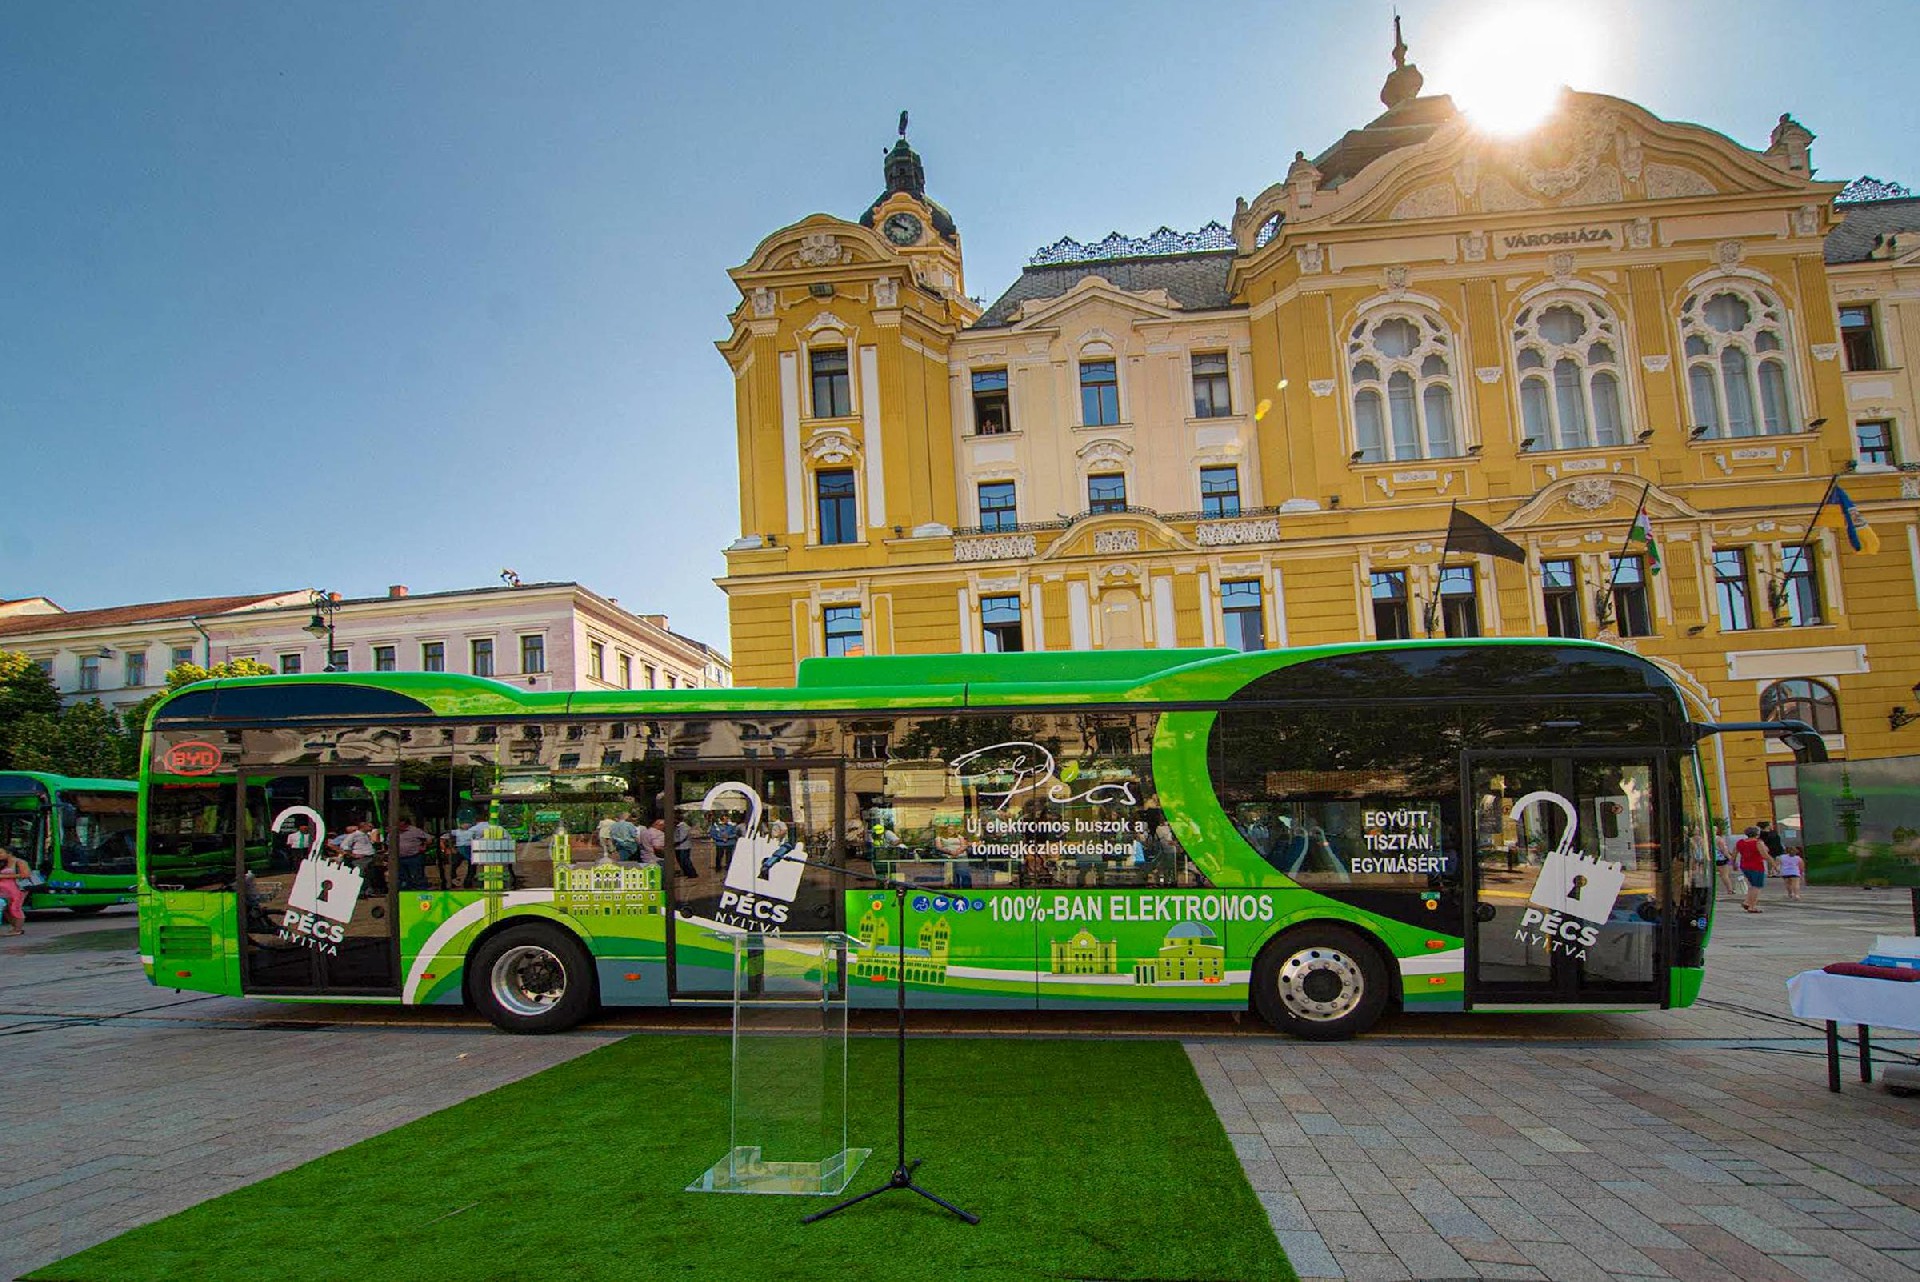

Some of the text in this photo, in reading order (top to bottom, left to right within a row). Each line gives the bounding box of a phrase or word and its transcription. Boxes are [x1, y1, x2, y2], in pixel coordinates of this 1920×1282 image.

[1503, 227, 1612, 248] VÁROSHÁZA
[986, 817, 1071, 833] elektromos
[1075, 817, 1134, 833] buszok
[1134, 821, 1144, 833] a
[1365, 808, 1432, 829] EGYÜTT,
[972, 840, 1137, 859] tömegközlekedésben!
[1364, 830, 1433, 851] TISZTÁN,
[1351, 854, 1448, 873] EGYMÁSÉRT
[719, 891, 789, 923] PÉCS
[989, 895, 1273, 922] 100%-BAN ELEKTROMOS
[283, 909, 345, 943] PÉCS
[715, 911, 780, 938] NYITVA
[1521, 908, 1599, 947] PÉCS
[279, 929, 337, 957] NYITVA
[1515, 929, 1587, 962] NYITVA
